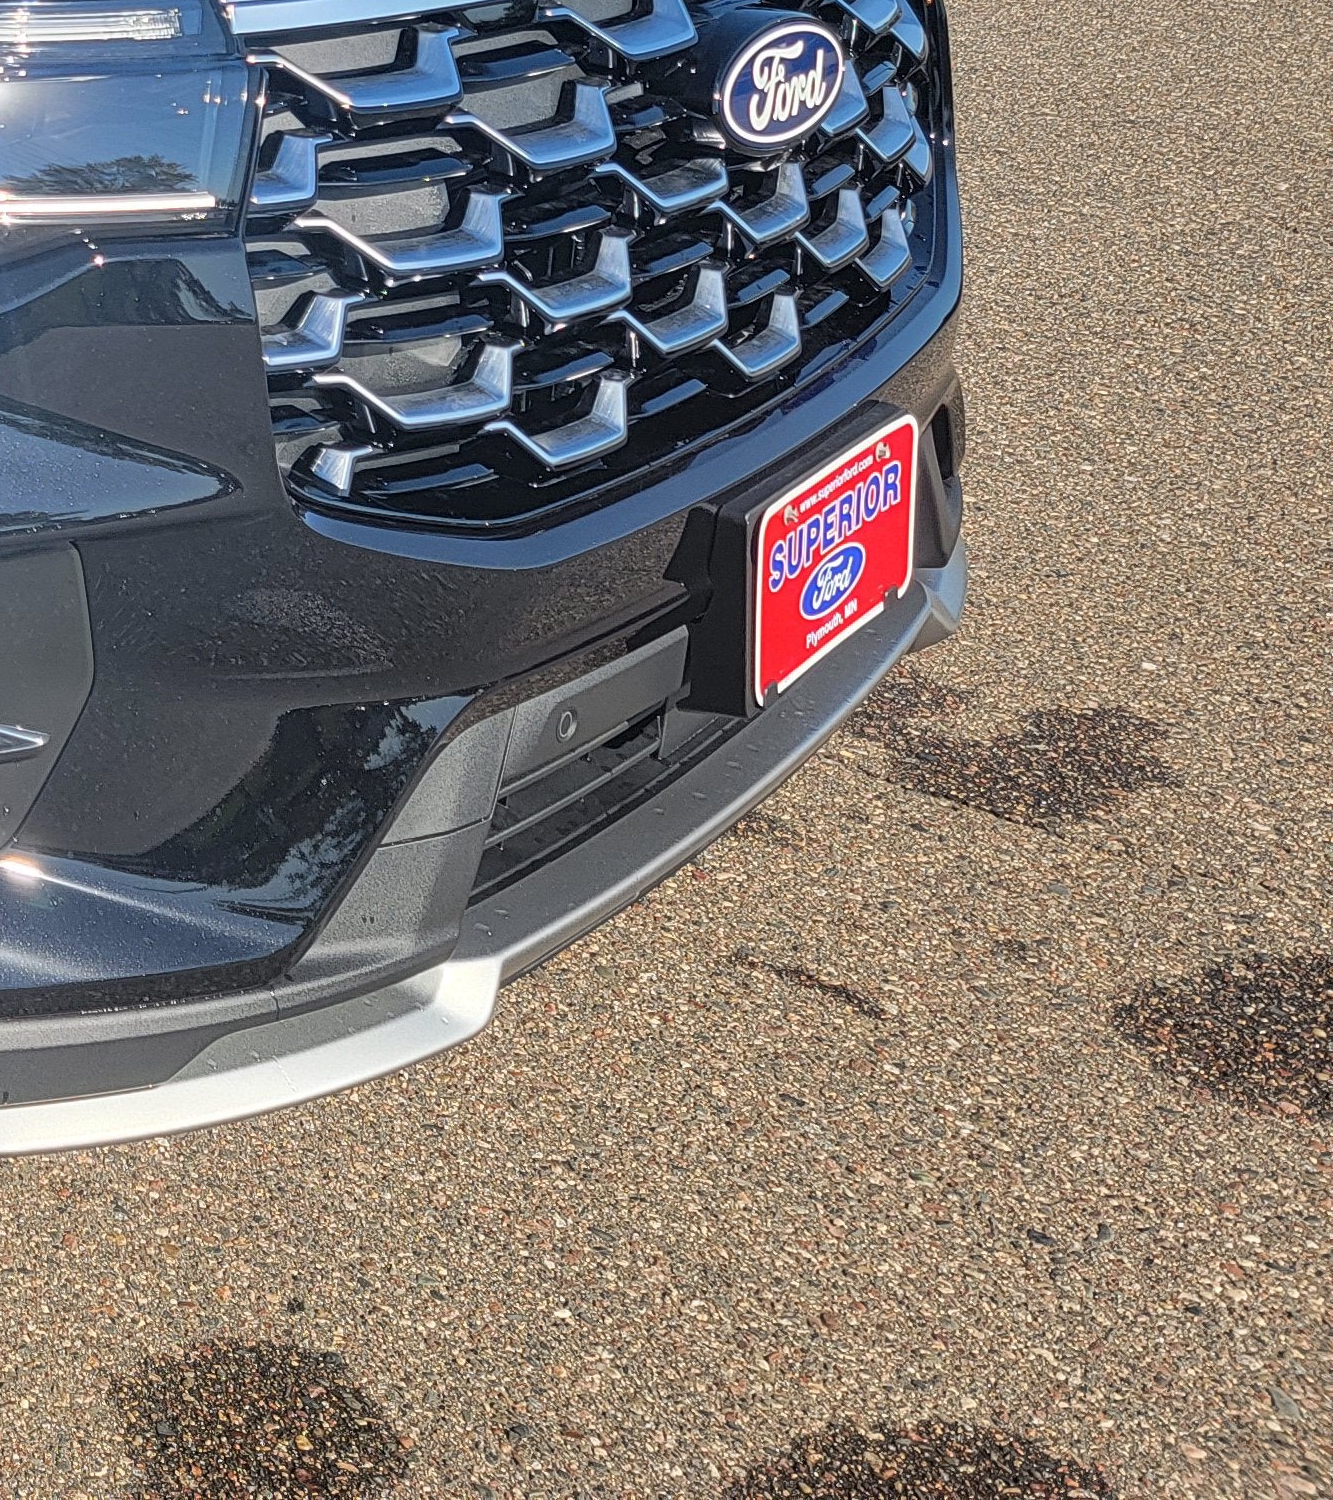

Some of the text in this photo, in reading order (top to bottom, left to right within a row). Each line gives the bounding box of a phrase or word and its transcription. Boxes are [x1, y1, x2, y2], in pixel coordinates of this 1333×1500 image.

[749, 40, 826, 132] Ford
[798, 454, 874, 514] www.superiorford.com
[768, 460, 902, 593] SUPERIOR
[812, 555, 853, 610] Ford
[806, 598, 858, 650] Plymouth, MN
